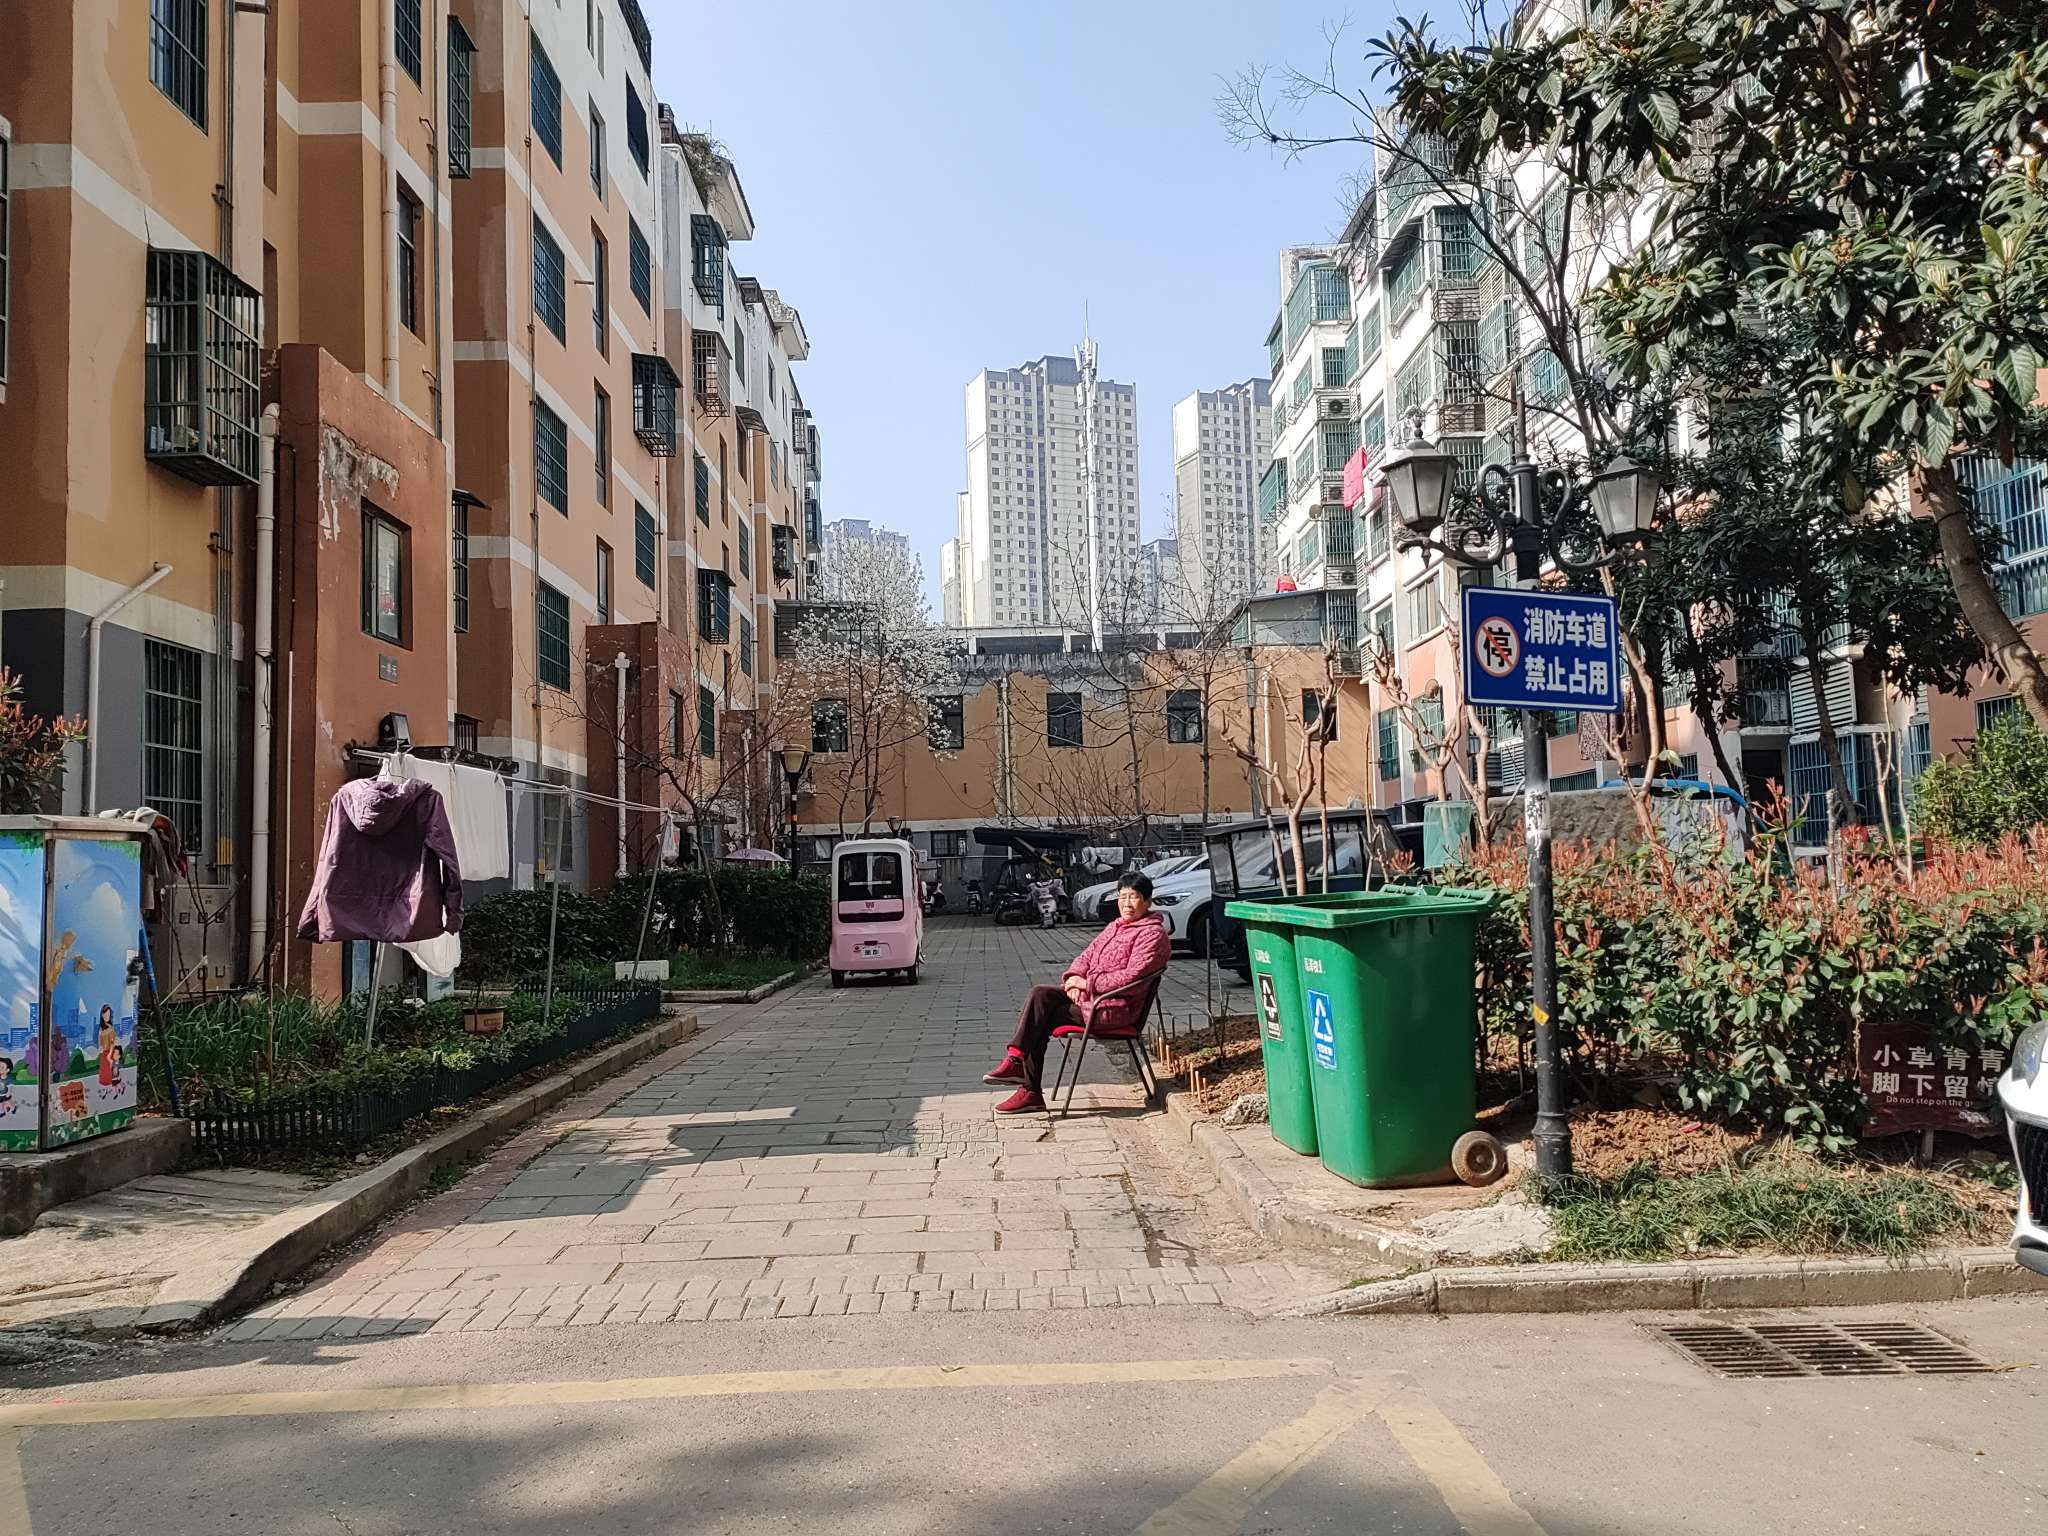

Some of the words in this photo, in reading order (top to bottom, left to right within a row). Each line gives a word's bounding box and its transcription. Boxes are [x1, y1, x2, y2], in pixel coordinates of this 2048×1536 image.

[1483, 626, 1513, 667] 停
[1523, 606, 1608, 649] 消防车道
[1523, 654, 1609, 696] 禁止占用
[1873, 1044, 2006, 1073] 小草青青
[1886, 1095, 1898, 1103] Do
[1899, 1096, 1914, 1104] not
[1916, 1097, 1935, 1107] step
[1948, 1098, 1963, 1107] the
